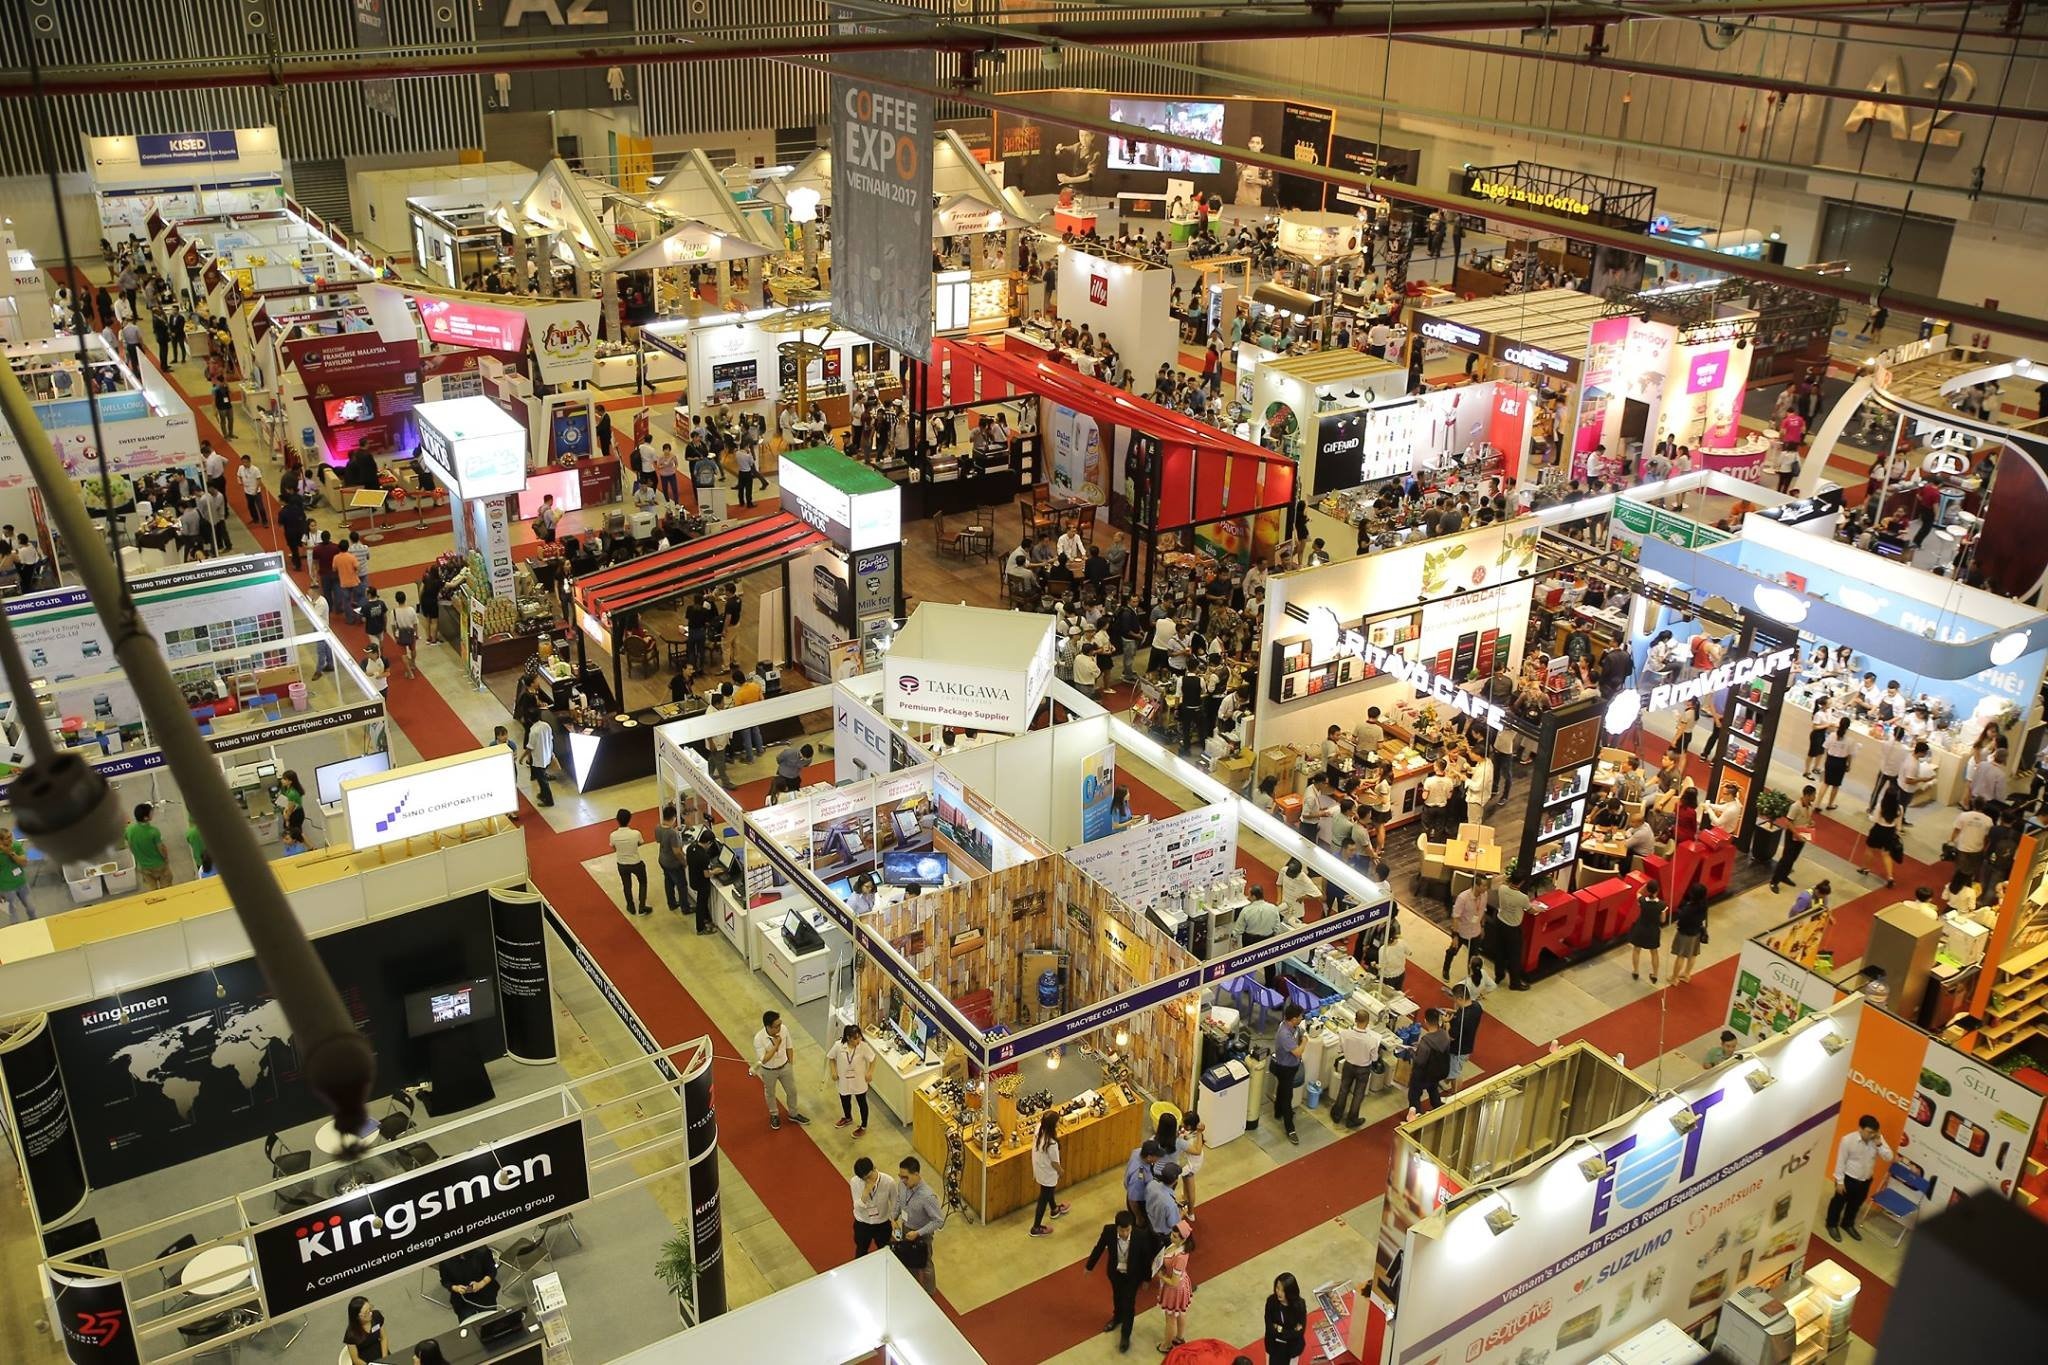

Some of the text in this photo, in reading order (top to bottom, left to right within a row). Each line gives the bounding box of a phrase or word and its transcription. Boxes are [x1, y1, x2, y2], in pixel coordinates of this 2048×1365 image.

[845, 88, 917, 134] COFFEE
[169, 138, 206, 151] KISED
[846, 121, 918, 181] EXPO
[846, 170, 917, 206] VIETNAM 2017
[1545, 194, 1589, 215] Coffee
[1091, 279, 1107, 303] illy
[323, 347, 387, 361] FRANCHISE MALAYSIA
[324, 358, 353, 367] PAVILION
[1323, 437, 1360, 454] GIFFARD
[800, 506, 827, 533] VOVOS
[858, 554, 888, 572] Barista
[132, 581, 155, 590] TRUNG
[155, 578, 173, 588] THUY
[173, 570, 228, 584] OPTOELECTRONIC
[242, 564, 254, 572] LTD
[5, 601, 35, 613] CTRONIC
[71, 593, 87, 602] H15
[858, 596, 892, 611] Milk for
[926, 679, 1010, 701] TAKIGAWA
[900, 701, 1010, 722] Premium Package Supplier
[215, 738, 241, 750] TRUNG
[241, 734, 261, 746] THUY
[261, 720, 323, 740] OPTOELECTRONIC
[339, 713, 352, 722] LTD
[364, 708, 377, 716] H14
[853, 718, 887, 756] FEC
[144, 756, 162, 766] H13
[402, 791, 494, 819] SINO CORPORATION
[1104, 929, 1127, 951] TRACY
[1231, 949, 1256, 969] GALAXY
[1256, 944, 1279, 963] WATER
[1279, 933, 1314, 955] SOLUTIONS
[1315, 923, 1342, 942] TRADING
[1369, 909, 1380, 919] 108
[1772, 969, 1801, 993] SEIL
[575, 946, 605, 988] Kingsmen
[604, 984, 630, 1022] Vietnam
[657, 1059, 670, 1077] Ltd
[1067, 1009, 1101, 1031] TRACYBEE
[1178, 978, 1190, 989] 107
[968, 1039, 979, 1052] 107
[1962, 1074, 1999, 1102] SEIL
[1779, 1149, 1811, 1179] rbs
[296, 1152, 552, 1263] Kingsmen
[1709, 1178, 1764, 1217] nantsune
[1503, 1148, 1765, 1302] Vietnam's Leader In Food & Retail Equipment Solutions
[305, 1192, 556, 1292] A Communication design and production group
[1599, 1227, 1673, 1283] SUZUMO
[76, 1309, 123, 1347] 25
